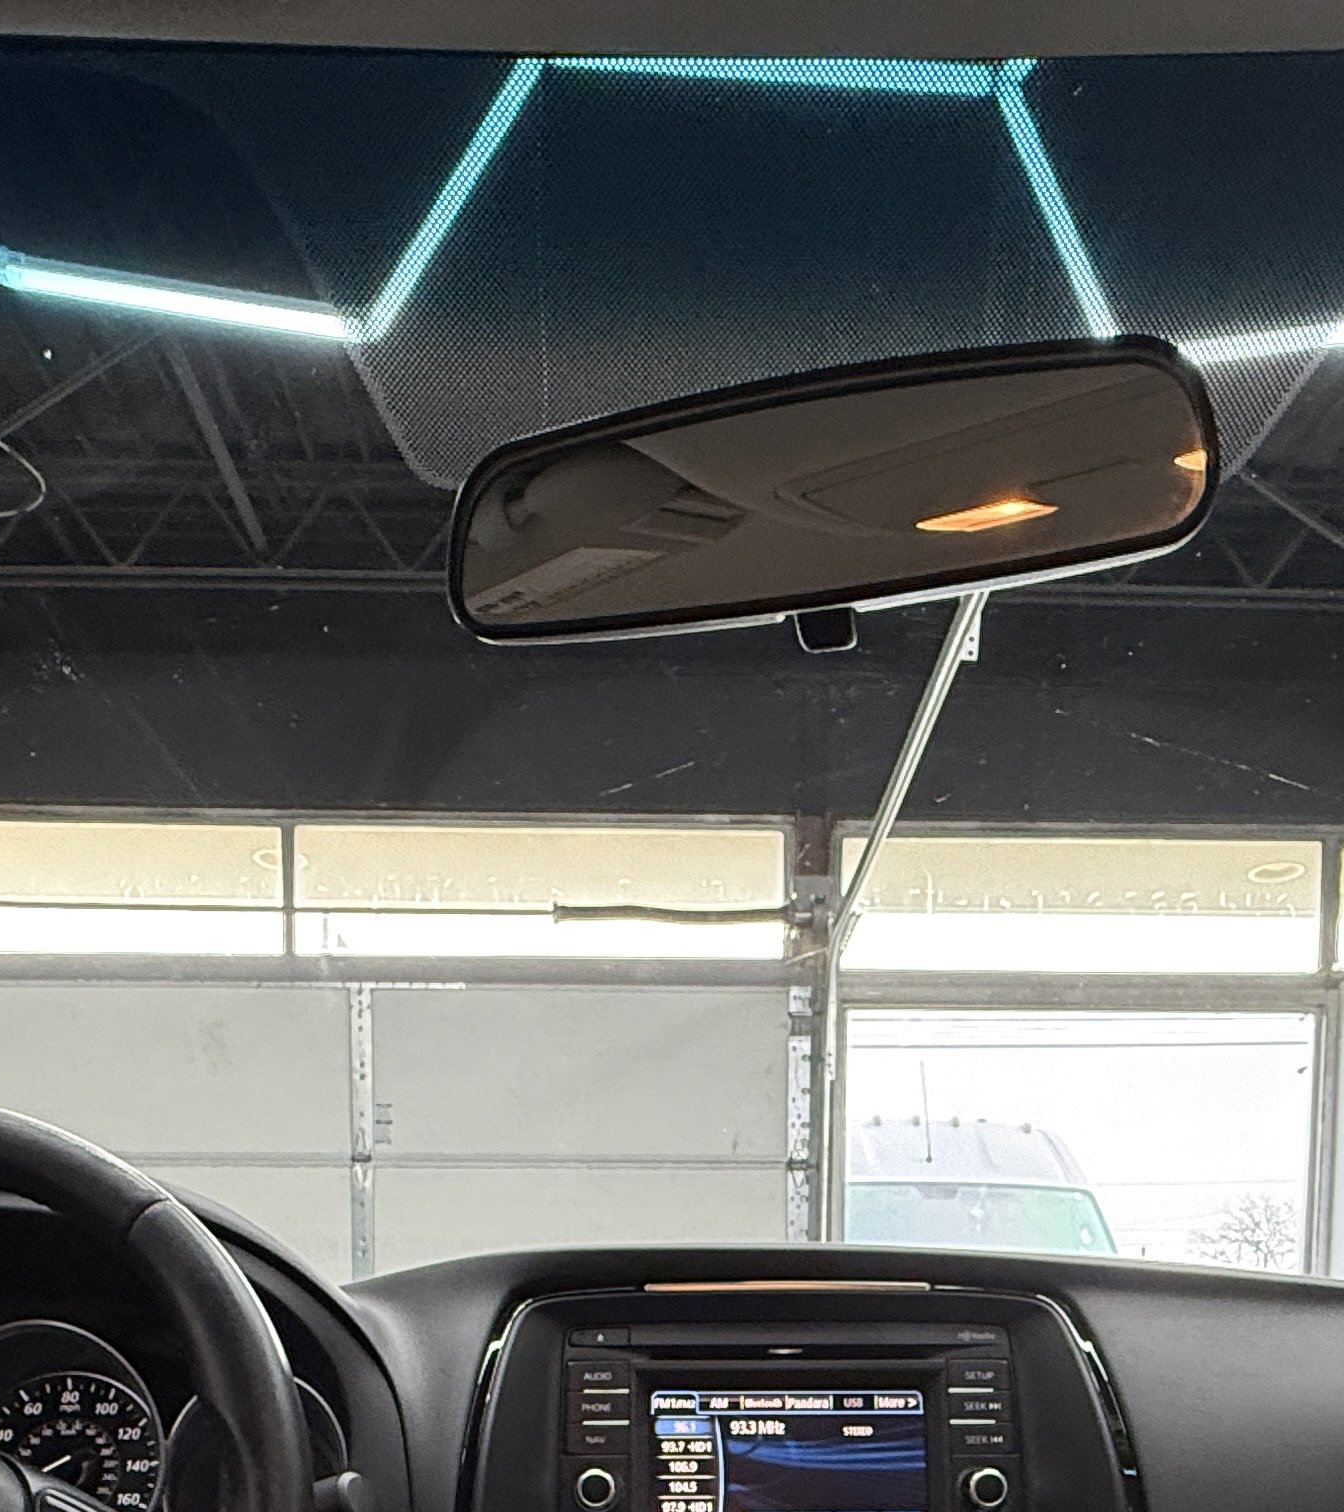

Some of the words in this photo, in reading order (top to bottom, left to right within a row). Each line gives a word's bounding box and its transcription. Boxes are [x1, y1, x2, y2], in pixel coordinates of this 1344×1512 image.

[583, 1372, 613, 1381] AUDIO
[965, 1371, 995, 1380] SETUP
[61, 1391, 80, 1403] 80
[709, 1397, 729, 1409] AM
[787, 1397, 829, 1409] Pandora
[843, 1398, 863, 1408] USB
[879, 1397, 906, 1409] More
[23, 1402, 43, 1415] 60
[59, 1404, 81, 1413] mph
[95, 1403, 119, 1415] 100
[581, 1403, 611, 1412] PHONE
[963, 1402, 987, 1411] SEEK
[117, 1428, 142, 1440] 120
[729, 1421, 757, 1435] 93.3
[758, 1421, 785, 1435] MHz
[585, 1436, 606, 1444] NAV
[965, 1435, 989, 1445] SEEK
[660, 1441, 685, 1453] 93.7
[126, 1460, 149, 1472] 140
[117, 1493, 140, 1506] 160
